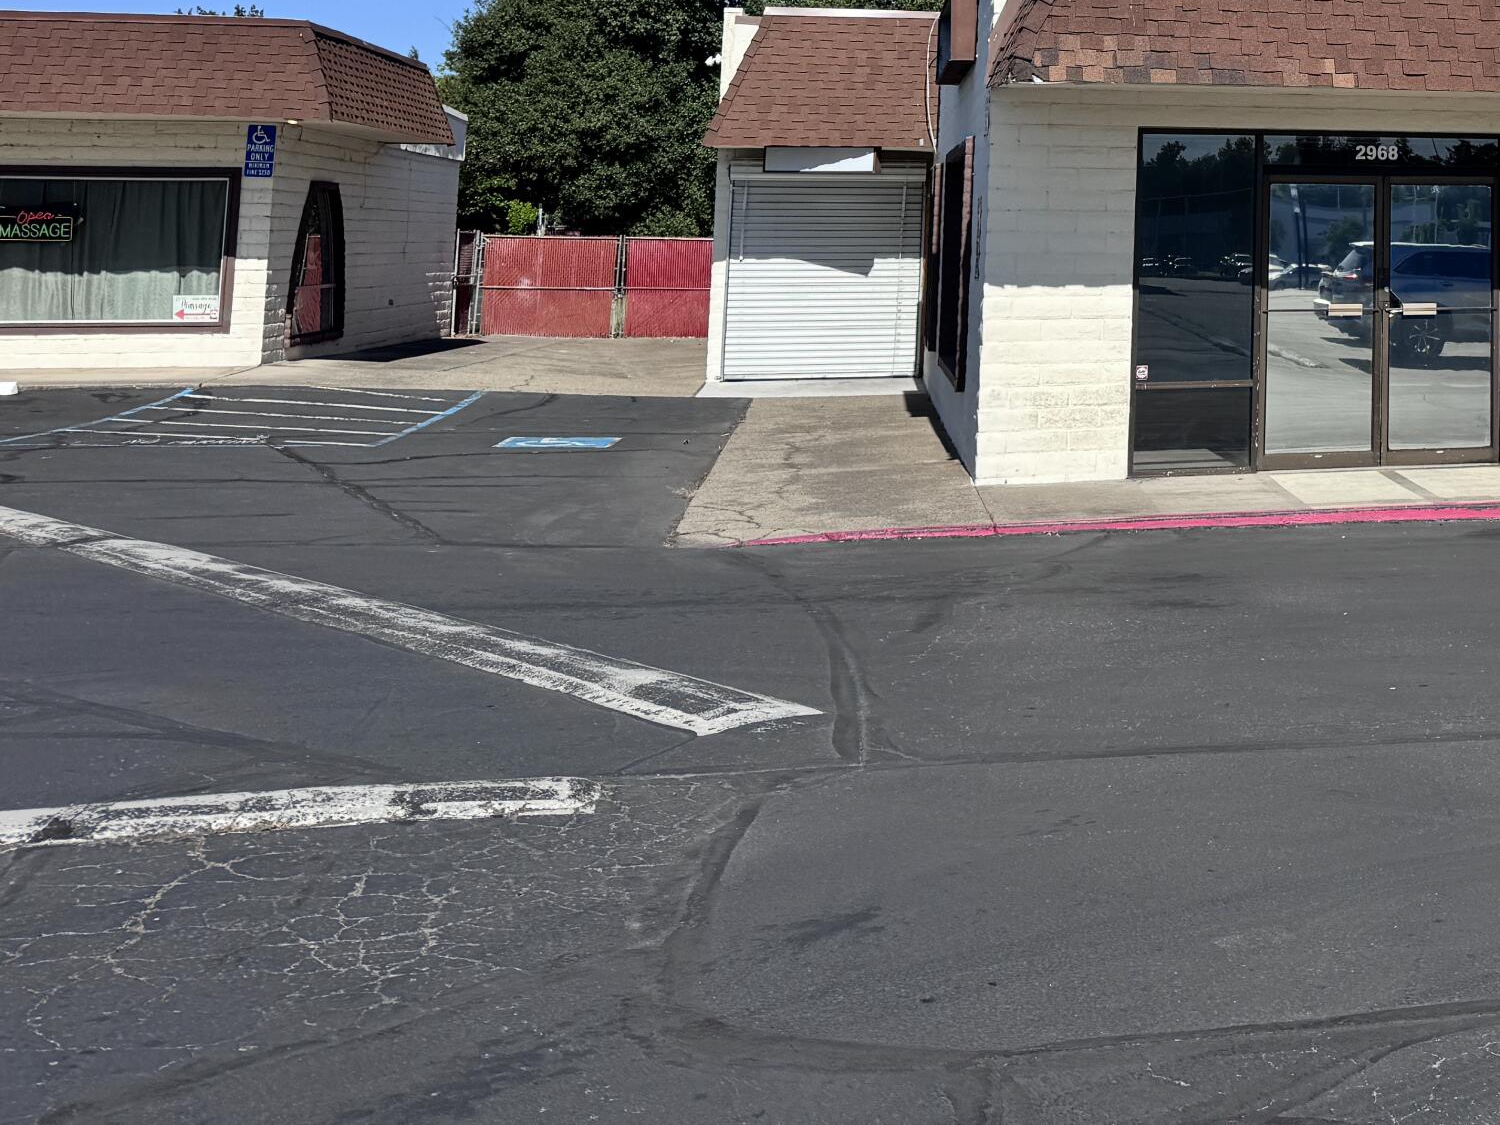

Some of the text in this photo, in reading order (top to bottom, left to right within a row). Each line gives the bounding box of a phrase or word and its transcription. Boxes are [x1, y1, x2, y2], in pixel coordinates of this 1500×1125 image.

[247, 144, 274, 153] PARKING
[1355, 145, 1399, 161] 2968
[17, 210, 55, 225] Open
[0, 223, 71, 238] MASSAGE
